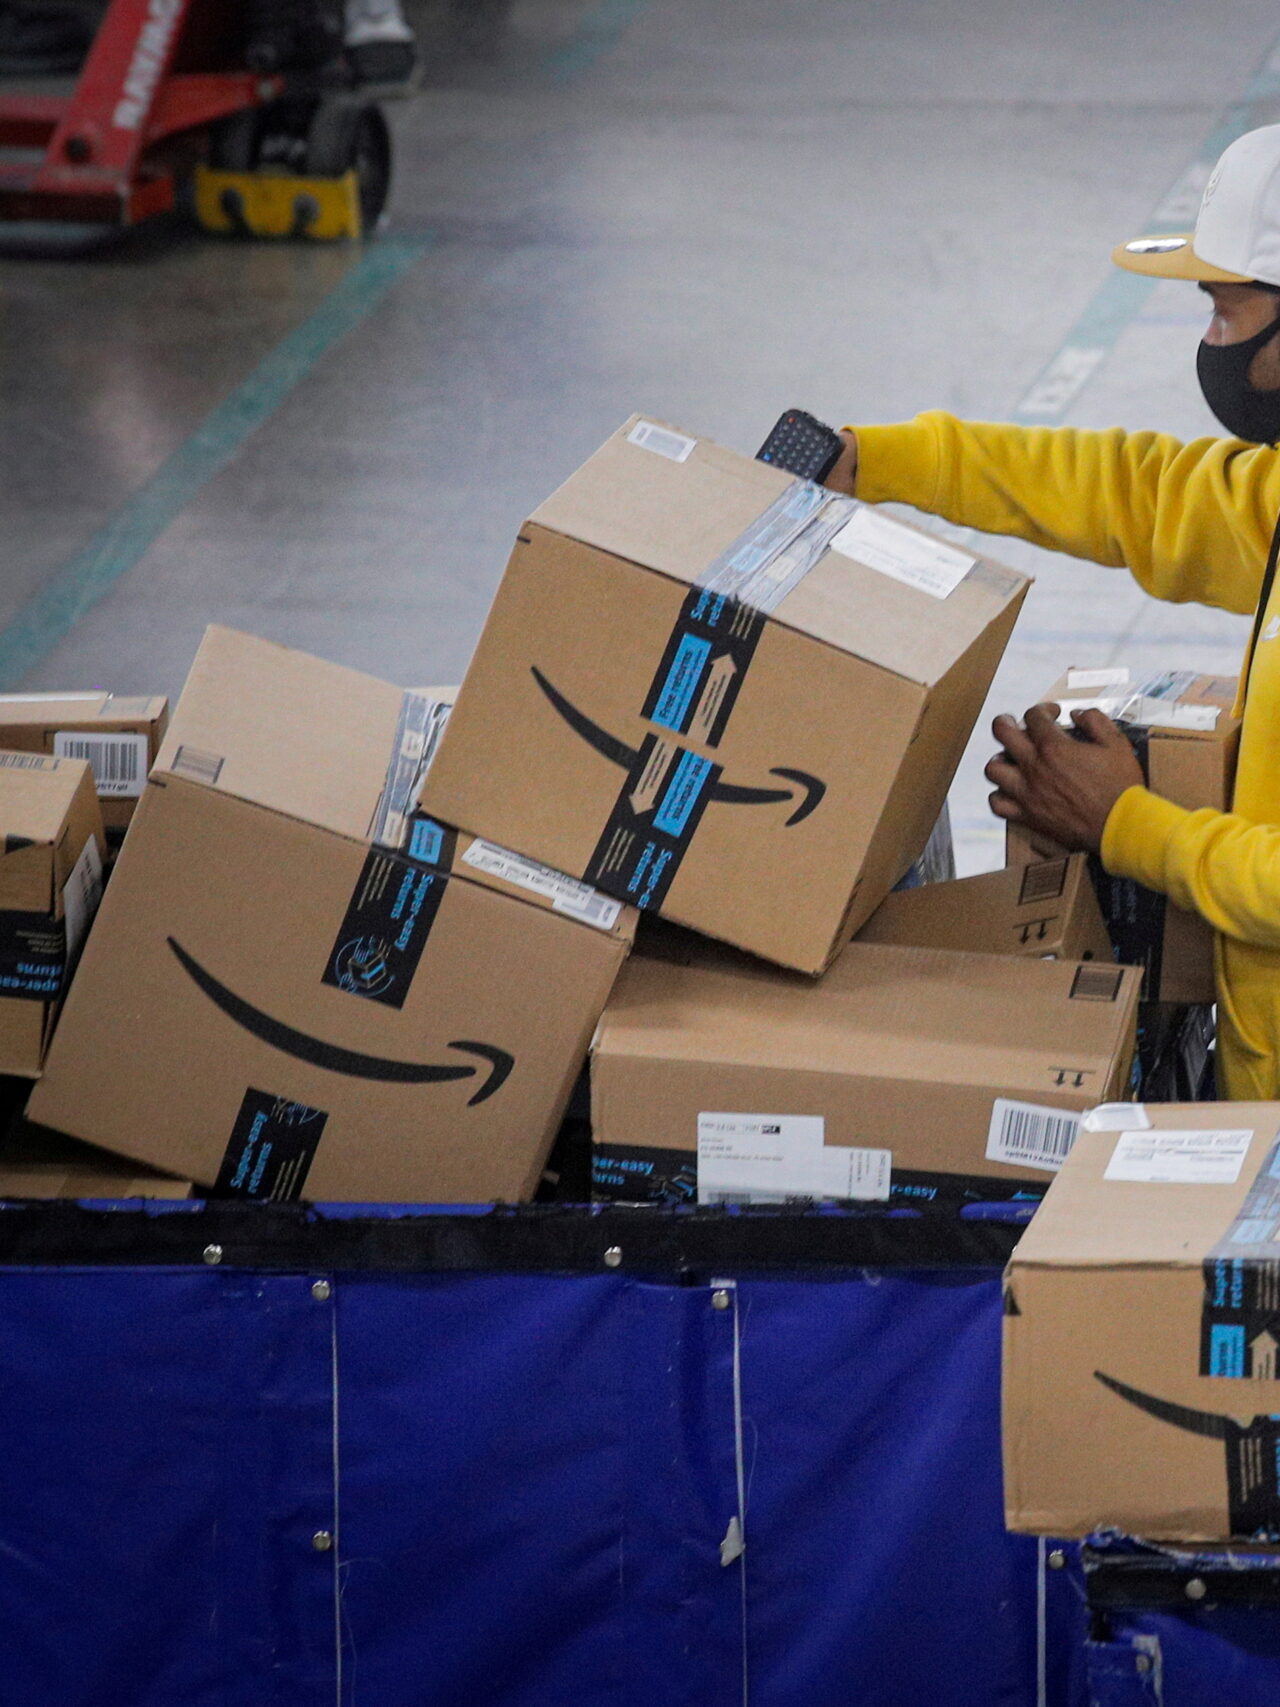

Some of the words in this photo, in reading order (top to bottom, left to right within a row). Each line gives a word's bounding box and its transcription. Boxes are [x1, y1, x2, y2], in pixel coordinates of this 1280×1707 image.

[390, 867, 416, 919] returns
[627, 841, 655, 892] returns
[394, 872, 434, 952] Super-easy
[230, 1110, 268, 1188] Super-easy
[247, 1141, 273, 1194] returns
